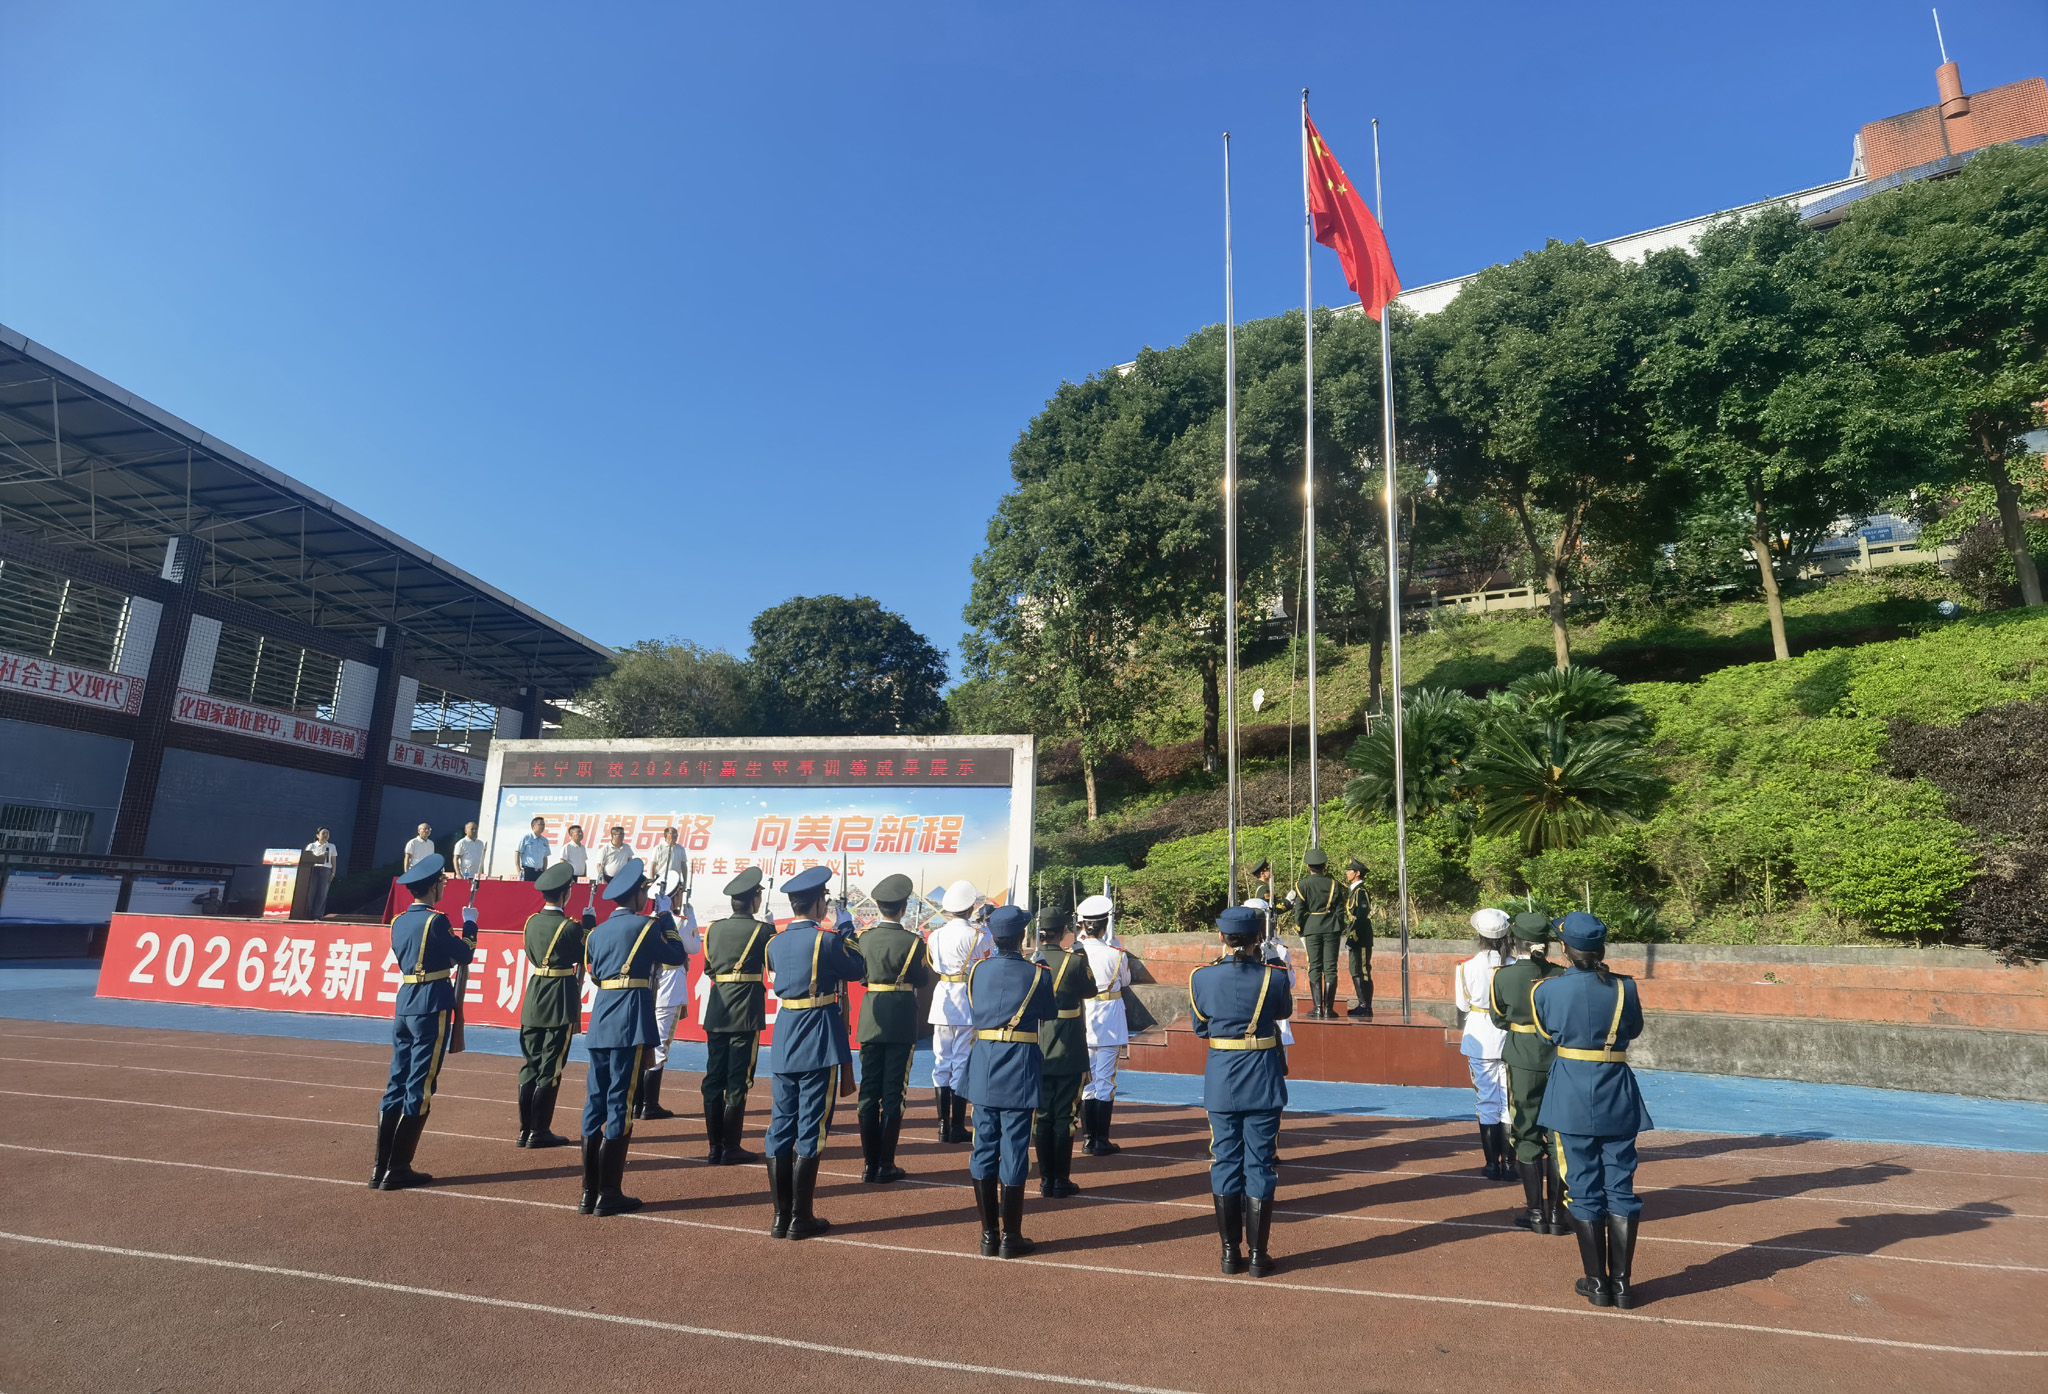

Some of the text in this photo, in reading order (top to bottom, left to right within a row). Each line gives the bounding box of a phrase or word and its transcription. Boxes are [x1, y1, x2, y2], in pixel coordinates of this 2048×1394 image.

[0, 656, 122, 704] 社会主义现代
[533, 813, 964, 854] 军训塑品格 向美启新程
